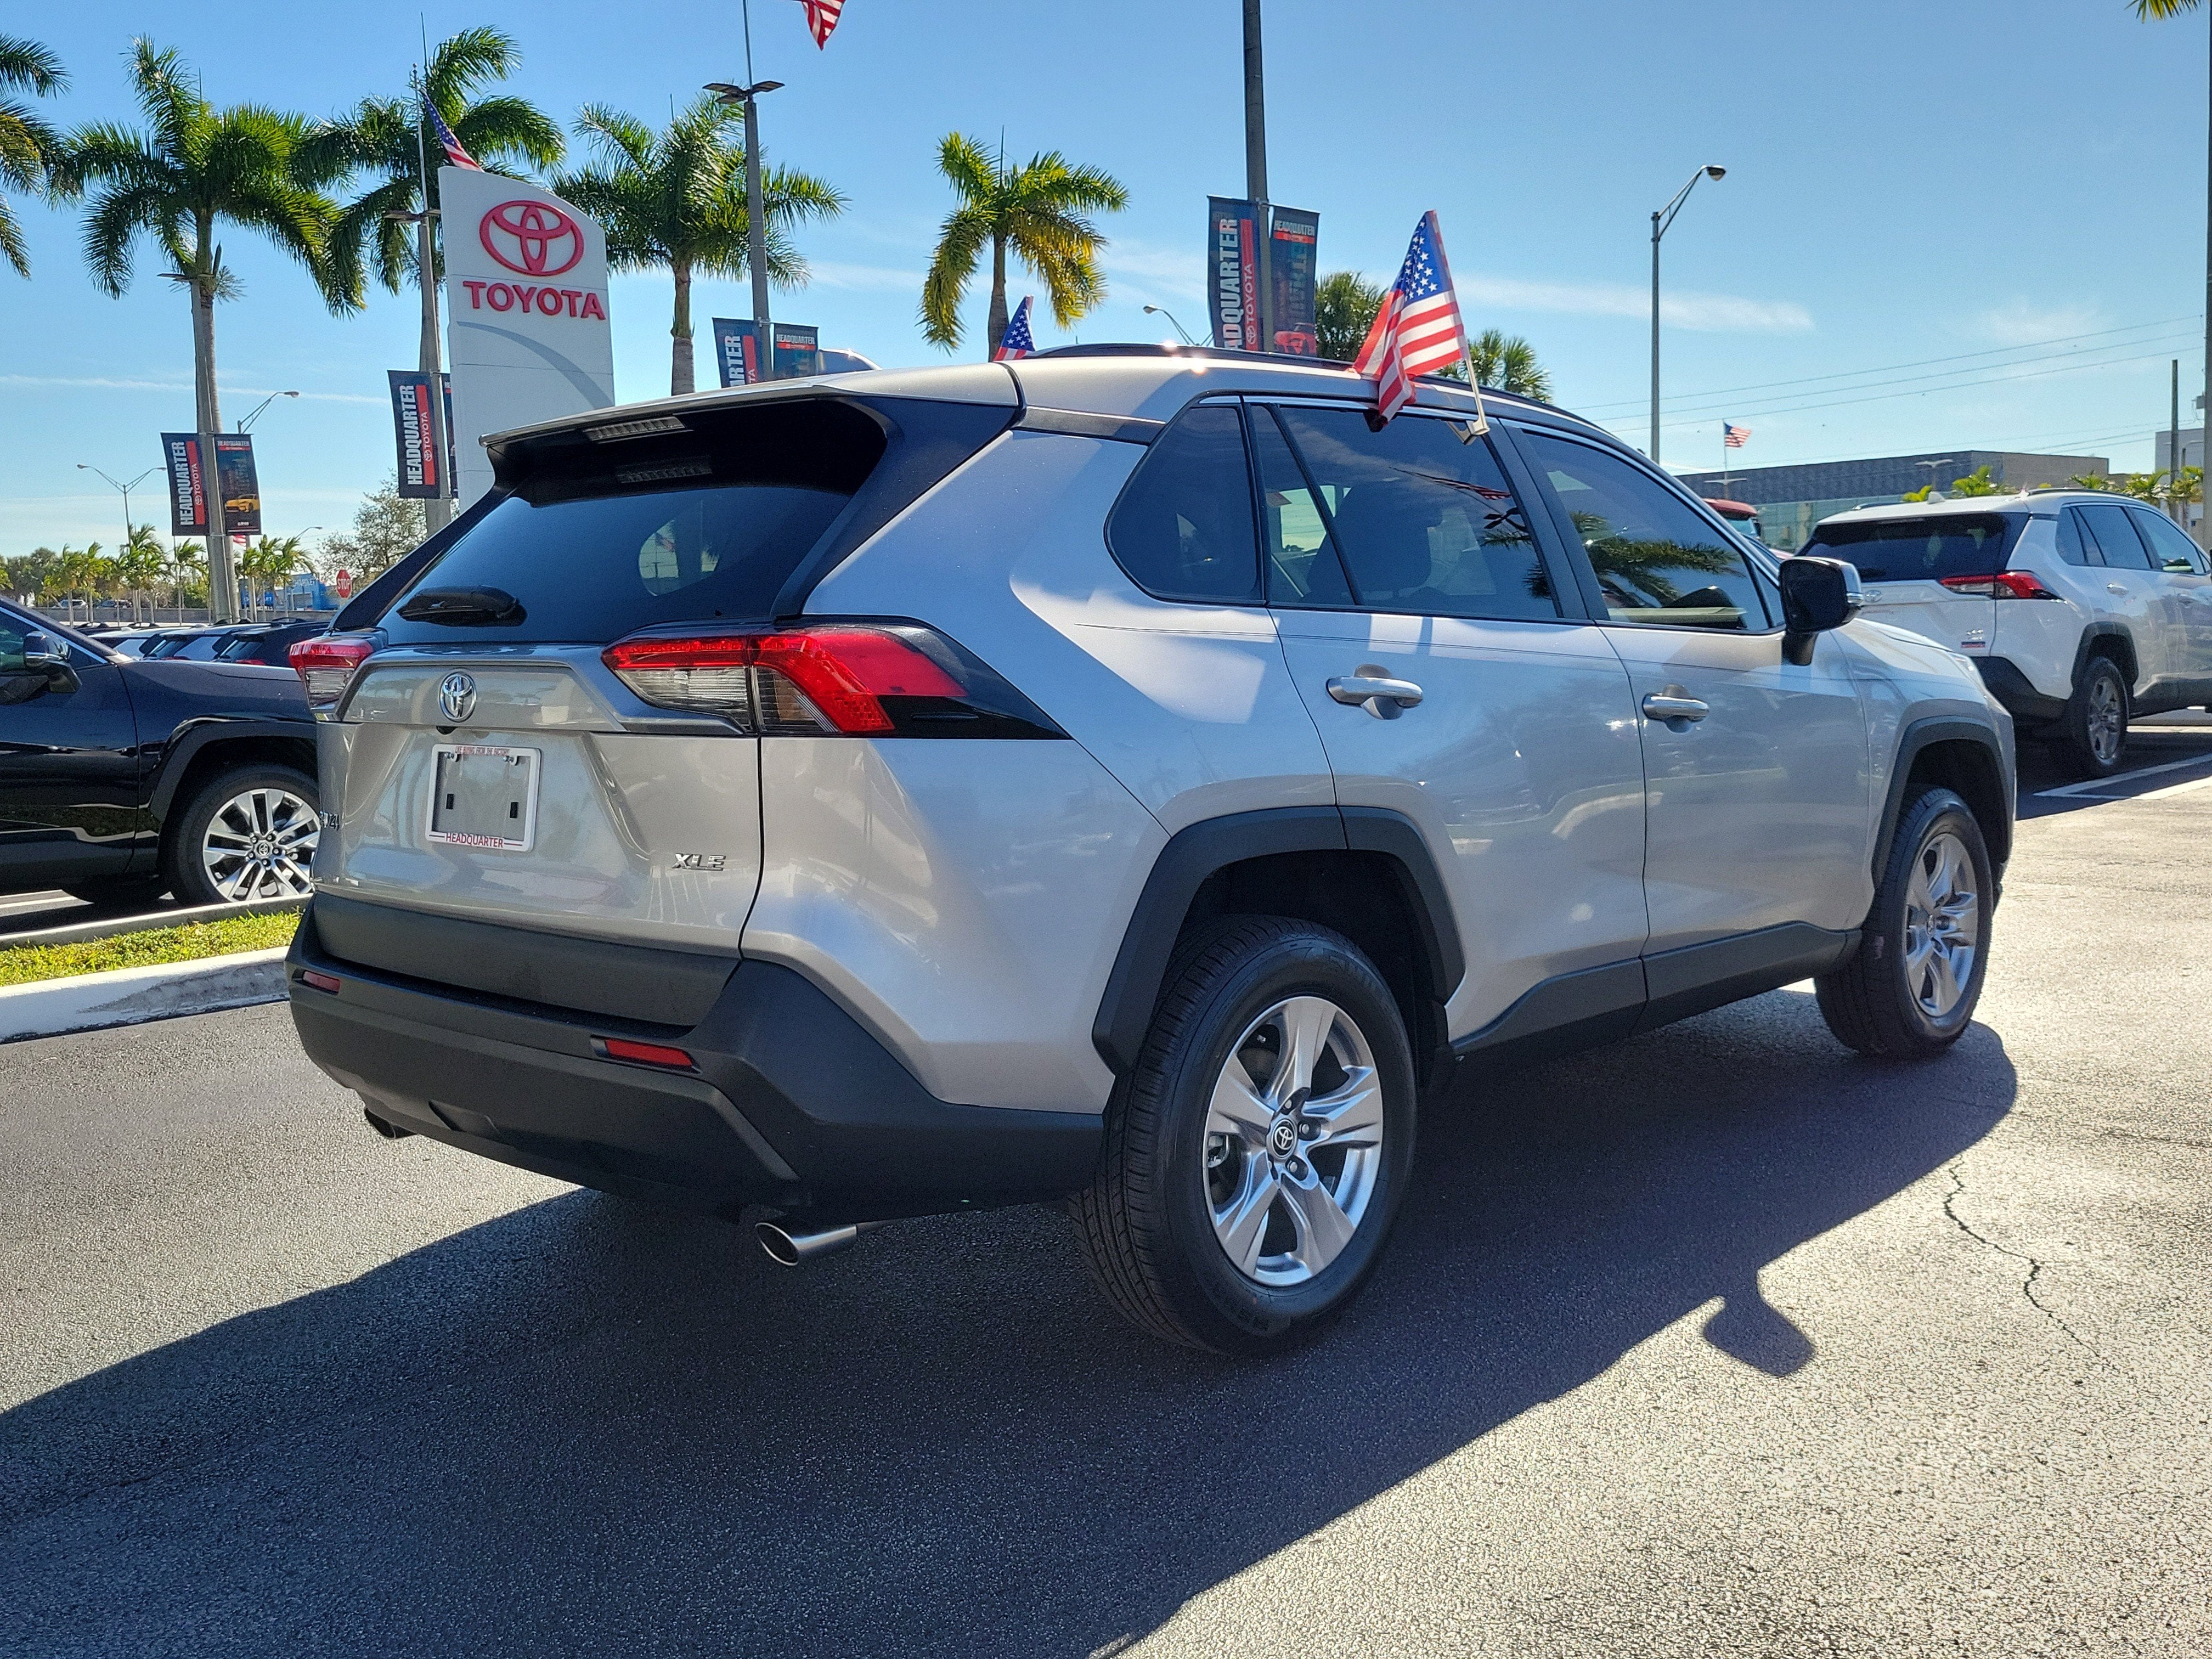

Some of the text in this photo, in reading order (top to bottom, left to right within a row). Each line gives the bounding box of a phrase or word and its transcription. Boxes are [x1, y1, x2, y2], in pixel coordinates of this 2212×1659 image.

[462, 280, 606, 320] TOYOTA
[1218, 219, 1244, 348] ADQUARTER
[1244, 263, 1255, 324] TOYOTA
[776, 334, 815, 345] HEADQUARTER
[399, 385, 424, 485] HEADQUARTER
[420, 412, 431, 449] TOYOTA
[171, 441, 194, 526] HEADQUARTER
[192, 464, 202, 494] TOYOTA
[337, 578, 350, 590] STOP
[446, 833, 504, 848] HEADQUARTER
[672, 853, 726, 871] XLE
